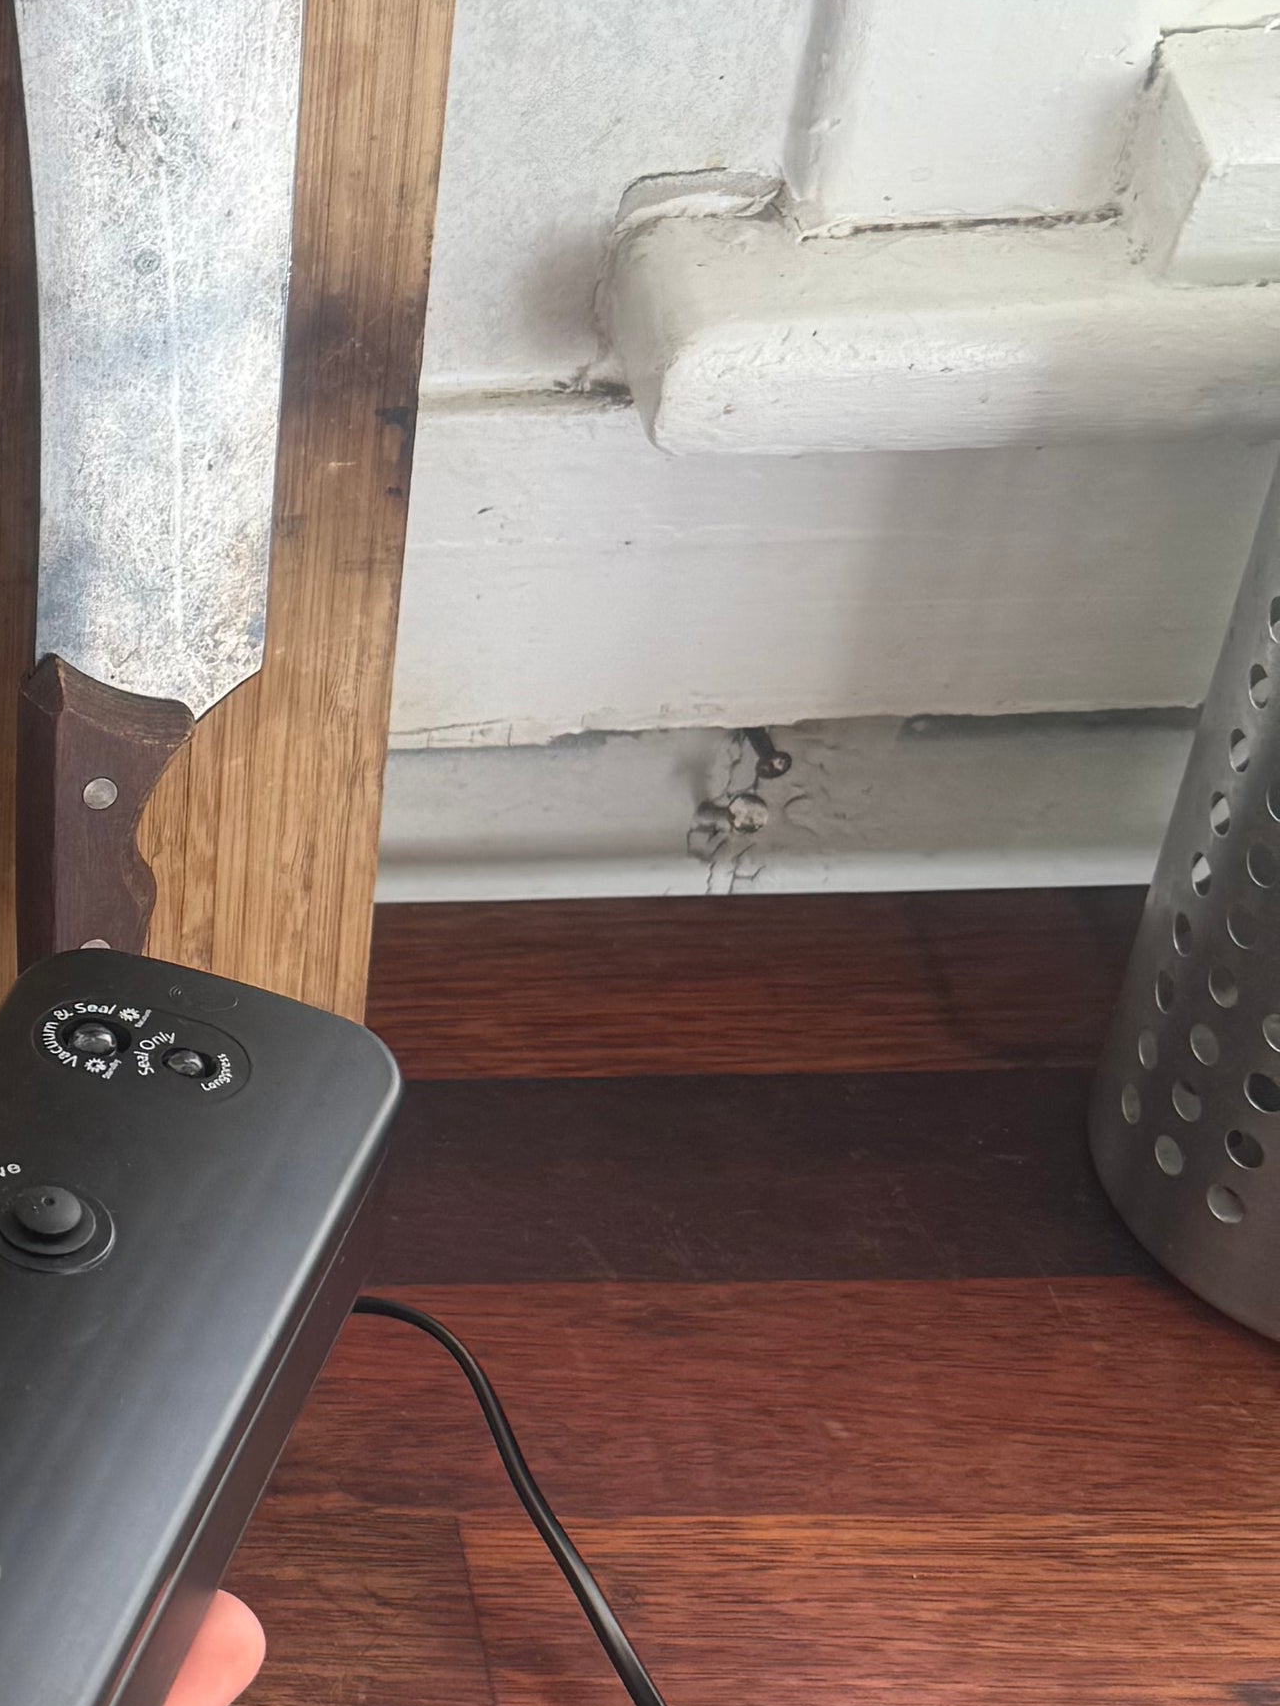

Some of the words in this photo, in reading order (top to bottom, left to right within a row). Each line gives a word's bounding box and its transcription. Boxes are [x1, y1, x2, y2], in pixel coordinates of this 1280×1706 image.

[52, 1007, 74, 1021] &
[73, 1000, 117, 1015] Seal
[41, 1019, 78, 1069] Vacuum
[138, 1030, 176, 1053] Only
[135, 1048, 155, 1077] Seal
